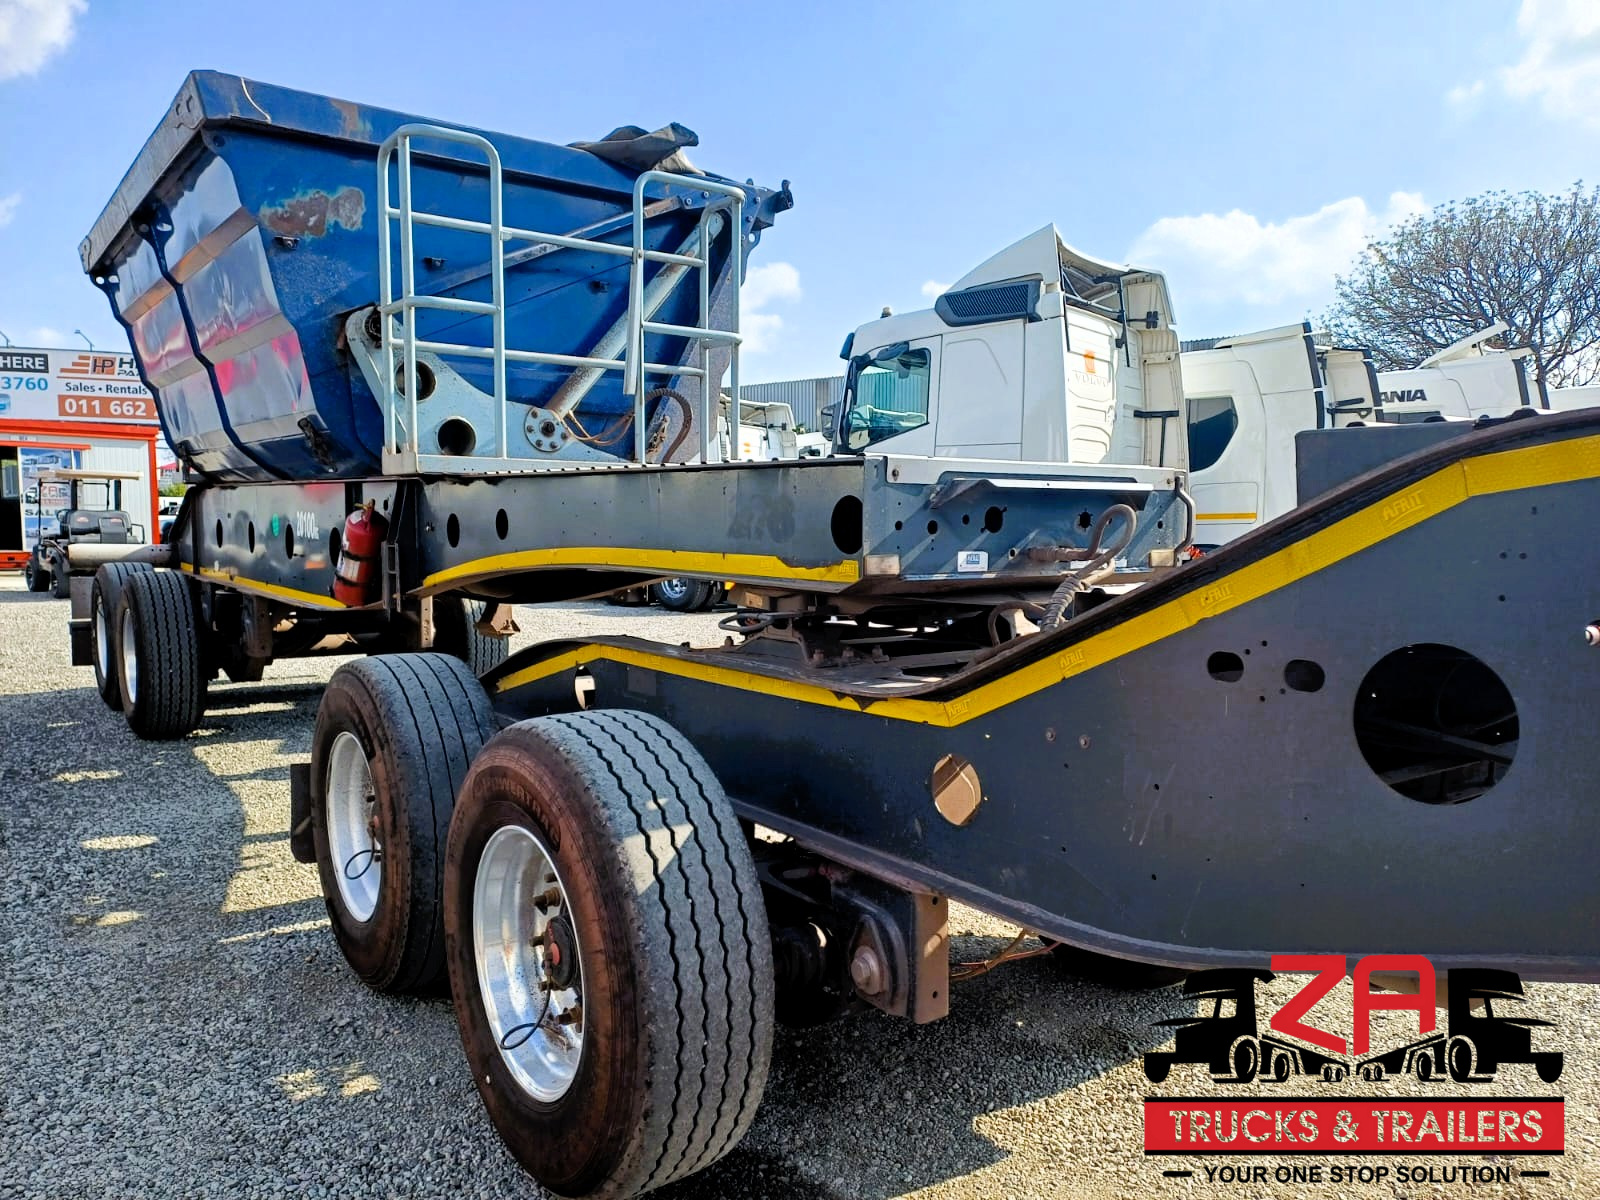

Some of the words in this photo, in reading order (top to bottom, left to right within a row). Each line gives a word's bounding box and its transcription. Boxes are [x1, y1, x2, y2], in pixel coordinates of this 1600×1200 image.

[0, 355, 45, 369] HERE
[117, 369, 140, 377] PA
[1, 376, 48, 391] 3760
[65, 382, 96, 393] Sales
[106, 384, 148, 395] Rentals
[1379, 389, 1427, 403] ANIA
[65, 398, 100, 415] 011
[109, 400, 147, 416] 662
[1383, 488, 1424, 520] AFRIT
